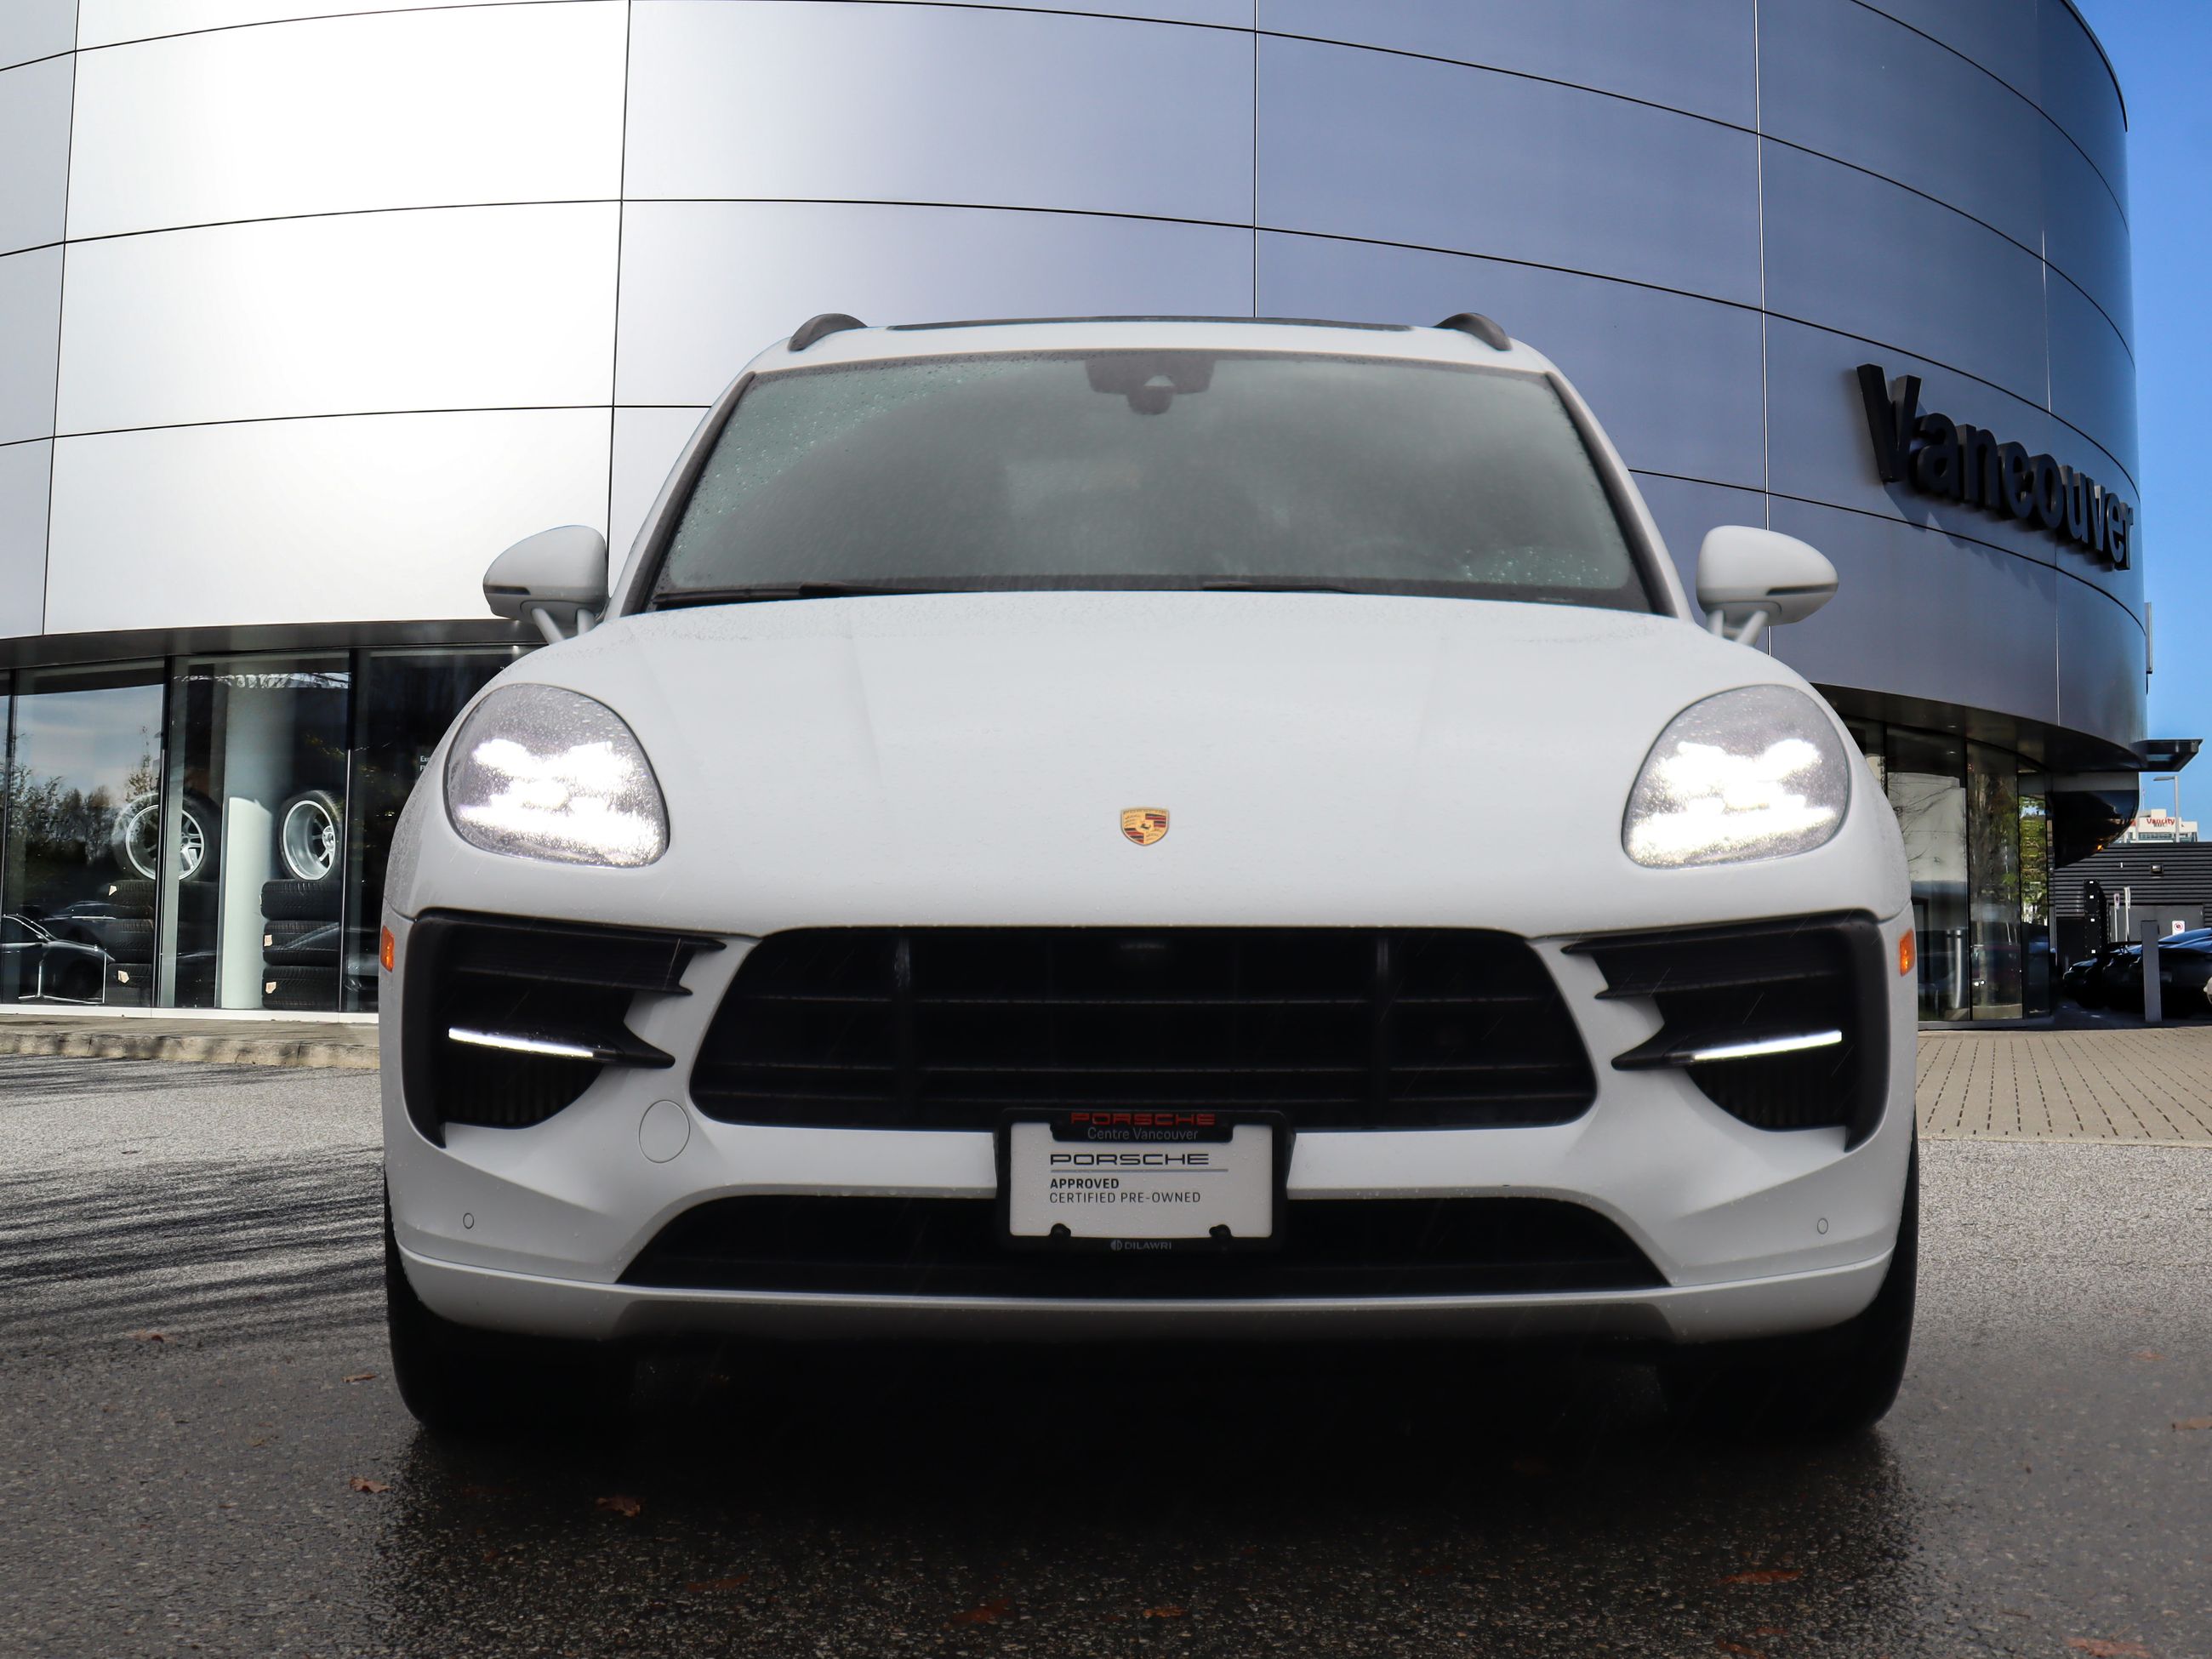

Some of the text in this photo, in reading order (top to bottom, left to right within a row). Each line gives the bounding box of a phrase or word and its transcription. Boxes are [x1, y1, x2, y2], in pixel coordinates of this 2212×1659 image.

[1857, 363, 2133, 571] Vancouver
[1070, 1112, 1216, 1126] PORSCHE
[1087, 1126, 1199, 1140] Centre Vancouver
[1050, 1154, 1209, 1166] PORSCHE
[1050, 1177, 1120, 1189] APPROVED
[1049, 1192, 1201, 1204] CERTIFIED PRE-OWNED
[1124, 1241, 1172, 1251] DILAWRI
